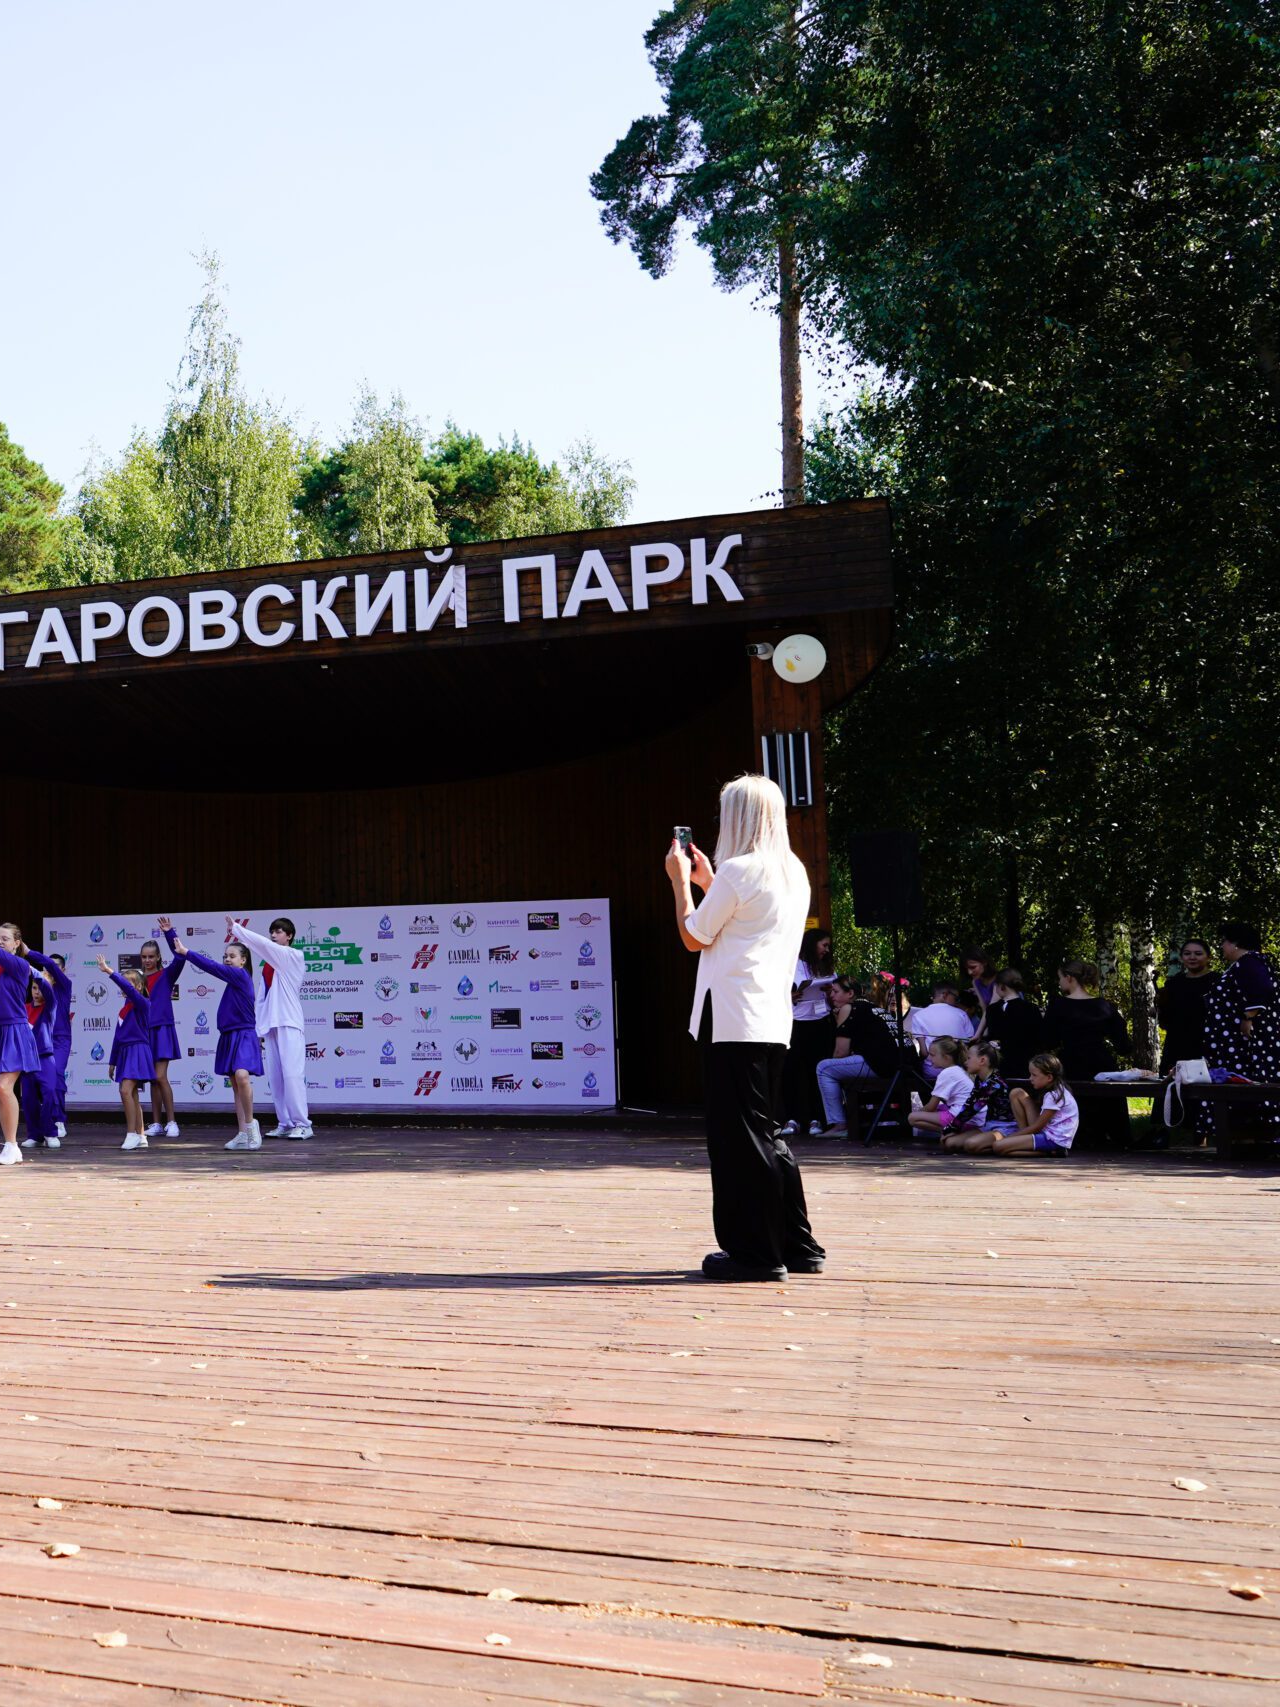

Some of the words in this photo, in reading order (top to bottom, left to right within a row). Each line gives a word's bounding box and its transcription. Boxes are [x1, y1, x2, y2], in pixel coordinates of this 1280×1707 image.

[502, 533, 744, 623] ПАРК
[448, 948, 480, 960] CANDELA
[489, 950, 520, 961] FENIX
[83, 1016, 111, 1028] CANDELA
[305, 1048, 326, 1058] ENIX
[451, 1075, 484, 1088] CANDELA
[492, 1080, 523, 1090] FENIX
